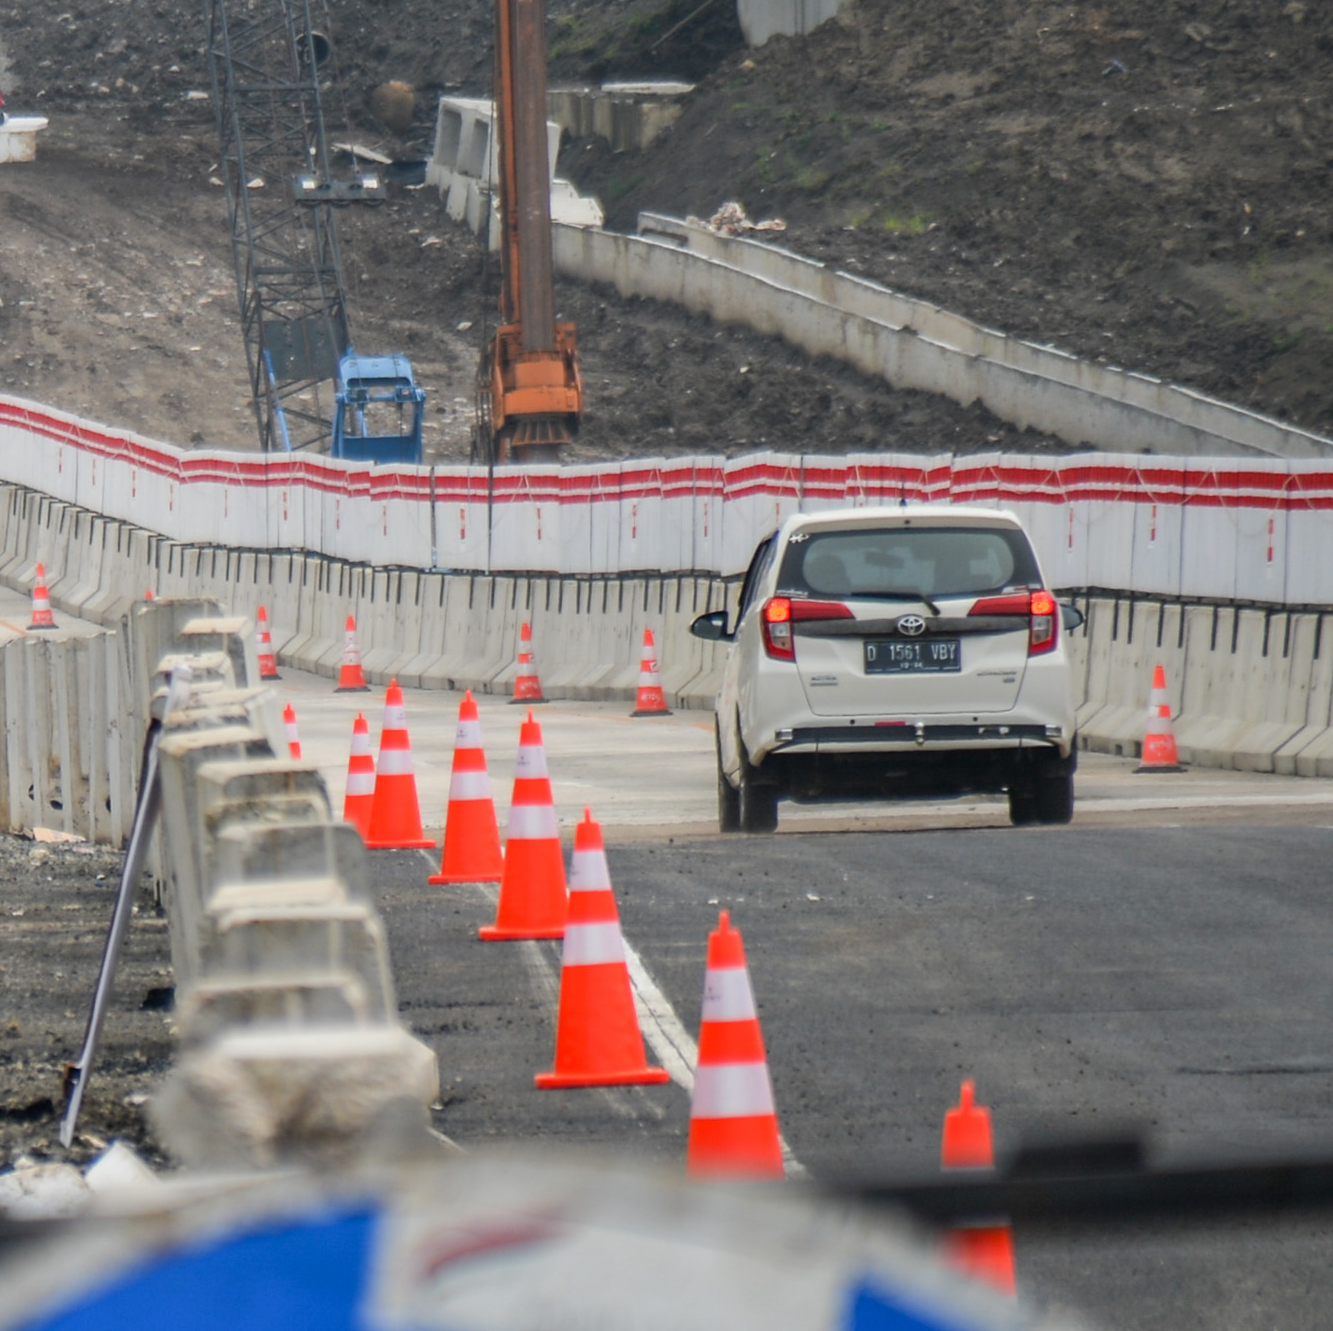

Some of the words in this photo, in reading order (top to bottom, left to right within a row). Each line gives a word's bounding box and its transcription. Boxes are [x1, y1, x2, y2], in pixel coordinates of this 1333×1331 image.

[866, 645, 877, 662] D
[889, 644, 921, 661] 1561
[931, 644, 956, 660] VBY
